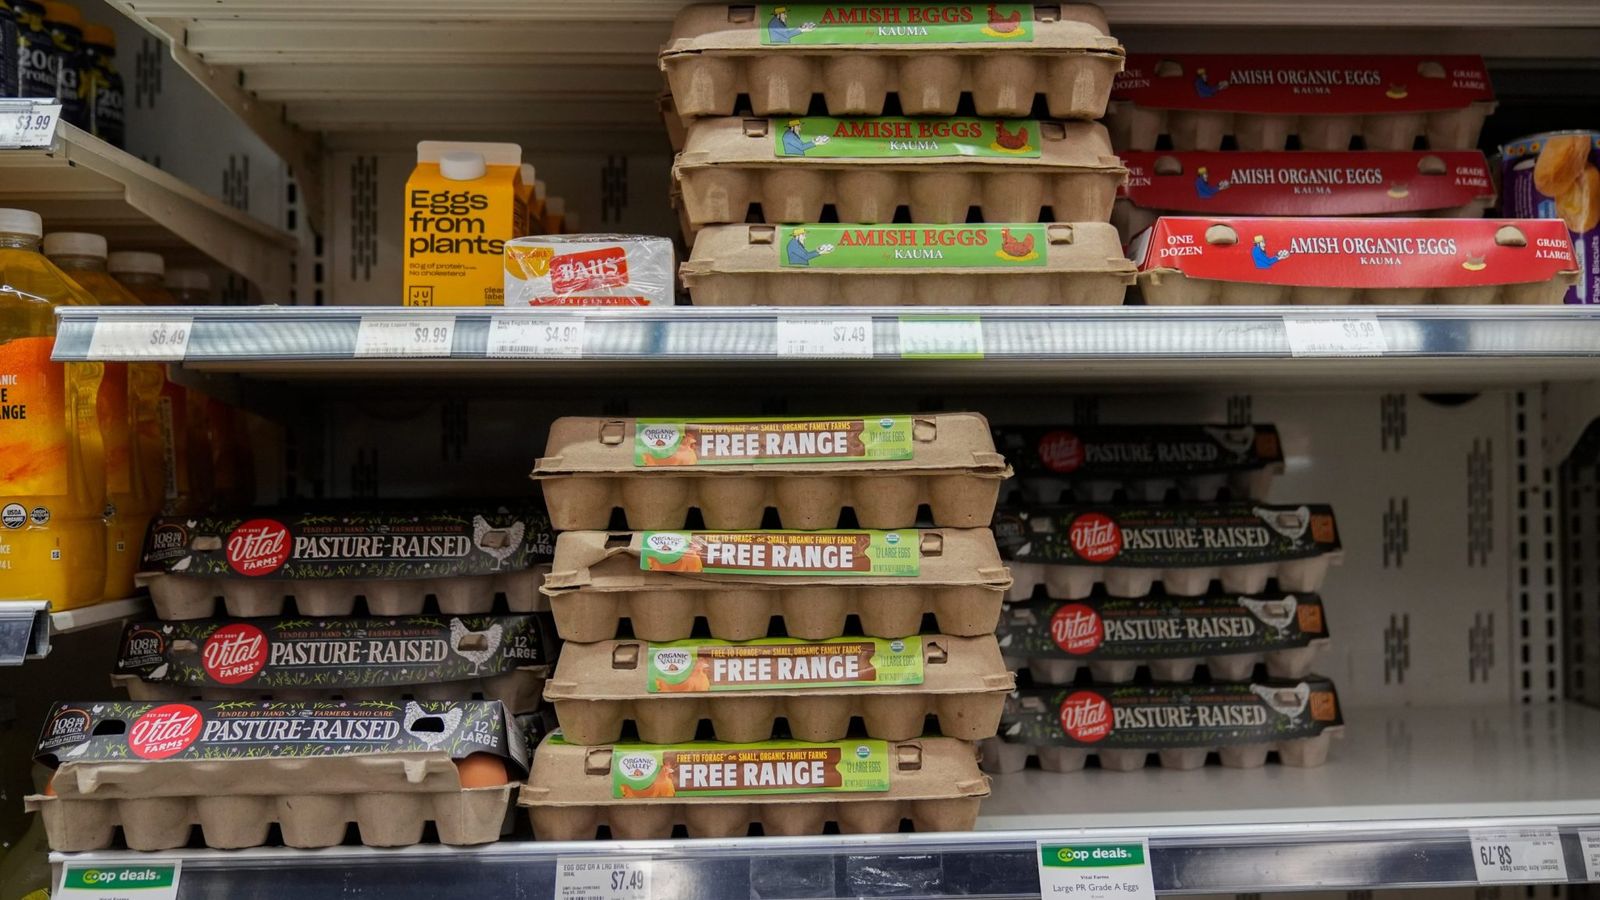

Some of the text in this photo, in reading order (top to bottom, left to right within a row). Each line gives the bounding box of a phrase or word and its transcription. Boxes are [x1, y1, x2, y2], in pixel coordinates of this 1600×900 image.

[820, 7, 973, 24] AMISH EGGS
[878, 26, 929, 36] KAUMA
[1230, 70, 1382, 86] AMISH ORGANIC EGGS
[16, 115, 51, 130] $3.99
[833, 121, 983, 139] AMISH EGGS
[889, 139, 940, 151] KAUMA
[1230, 168, 1383, 185] AMISH ORGANIC EGGS
[1456, 167, 1485, 177] GRADE
[1293, 186, 1332, 195] KAUMA
[1463, 178, 1488, 188] LARGE
[411, 190, 489, 216] Eggs
[409, 210, 486, 234] from
[838, 229, 988, 246] AMISH EGGS
[1168, 235, 1194, 245] ONE
[1536, 238, 1568, 248] GRADE
[409, 233, 505, 259] plants
[895, 248, 944, 259] KAUMA
[1160, 246, 1203, 258] DOZEN
[1290, 238, 1457, 256] AMISH ORGANIC EGGS
[1360, 257, 1402, 266] KAUMA
[1535, 250, 1571, 261] A LARGE
[1591, 236, 1600, 274] Biscuits
[150, 330, 186, 345] $6.49
[414, 328, 448, 344] $9.99
[833, 327, 866, 342] $7.49
[701, 434, 760, 457] FREE
[766, 431, 848, 456] RANGE
[537, 532, 549, 544] 12
[1072, 520, 1115, 550] Vital
[1123, 527, 1270, 550] PASTURE-RAISED
[229, 527, 286, 562] Vital
[293, 535, 472, 560] PASTURE-RAISED
[243, 556, 278, 571] FARMS
[707, 543, 766, 567] FREE
[772, 545, 854, 568] RANGE
[1052, 612, 1096, 643] Vital
[1103, 616, 1254, 641] PASTURE-RAISED
[130, 637, 150, 651] 108
[514, 636, 527, 648] 12
[204, 631, 263, 670] Vital
[270, 639, 449, 667] PASTURE-RAISED
[502, 647, 537, 660] LARGE
[657, 652, 689, 661] ORGANIC
[660, 658, 686, 666] VALLEY
[713, 658, 772, 682] FREE
[778, 655, 859, 681] RANGE
[219, 663, 255, 679] FARMS
[217, 710, 248, 718] TENDED
[250, 710, 261, 718] BY
[262, 710, 285, 718] HAND
[374, 709, 394, 717] CARE
[1060, 700, 1106, 732] Vital
[1112, 704, 1266, 729] PASTURE-RAISED
[53, 717, 75, 732] 108
[132, 711, 198, 746] Vital
[202, 718, 401, 743] PASTURE-RAISED
[474, 721, 489, 734] 12
[144, 739, 183, 754] FARMS
[461, 732, 499, 748] LARGE
[622, 757, 654, 766] ORGANIC
[676, 753, 692, 763] FREE
[760, 751, 786, 761] ORGANIC
[787, 751, 808, 760] FAMILY
[808, 750, 828, 760] FARMS
[625, 762, 651, 771] VALLEY
[679, 762, 738, 788] FREE
[744, 761, 825, 787] RANGE
[1480, 845, 1512, 866] $8.79
[611, 871, 644, 893] $7.49
[1053, 884, 1074, 893] Large
[1088, 883, 1112, 892] Grade
[1123, 884, 1139, 893] Eggs
